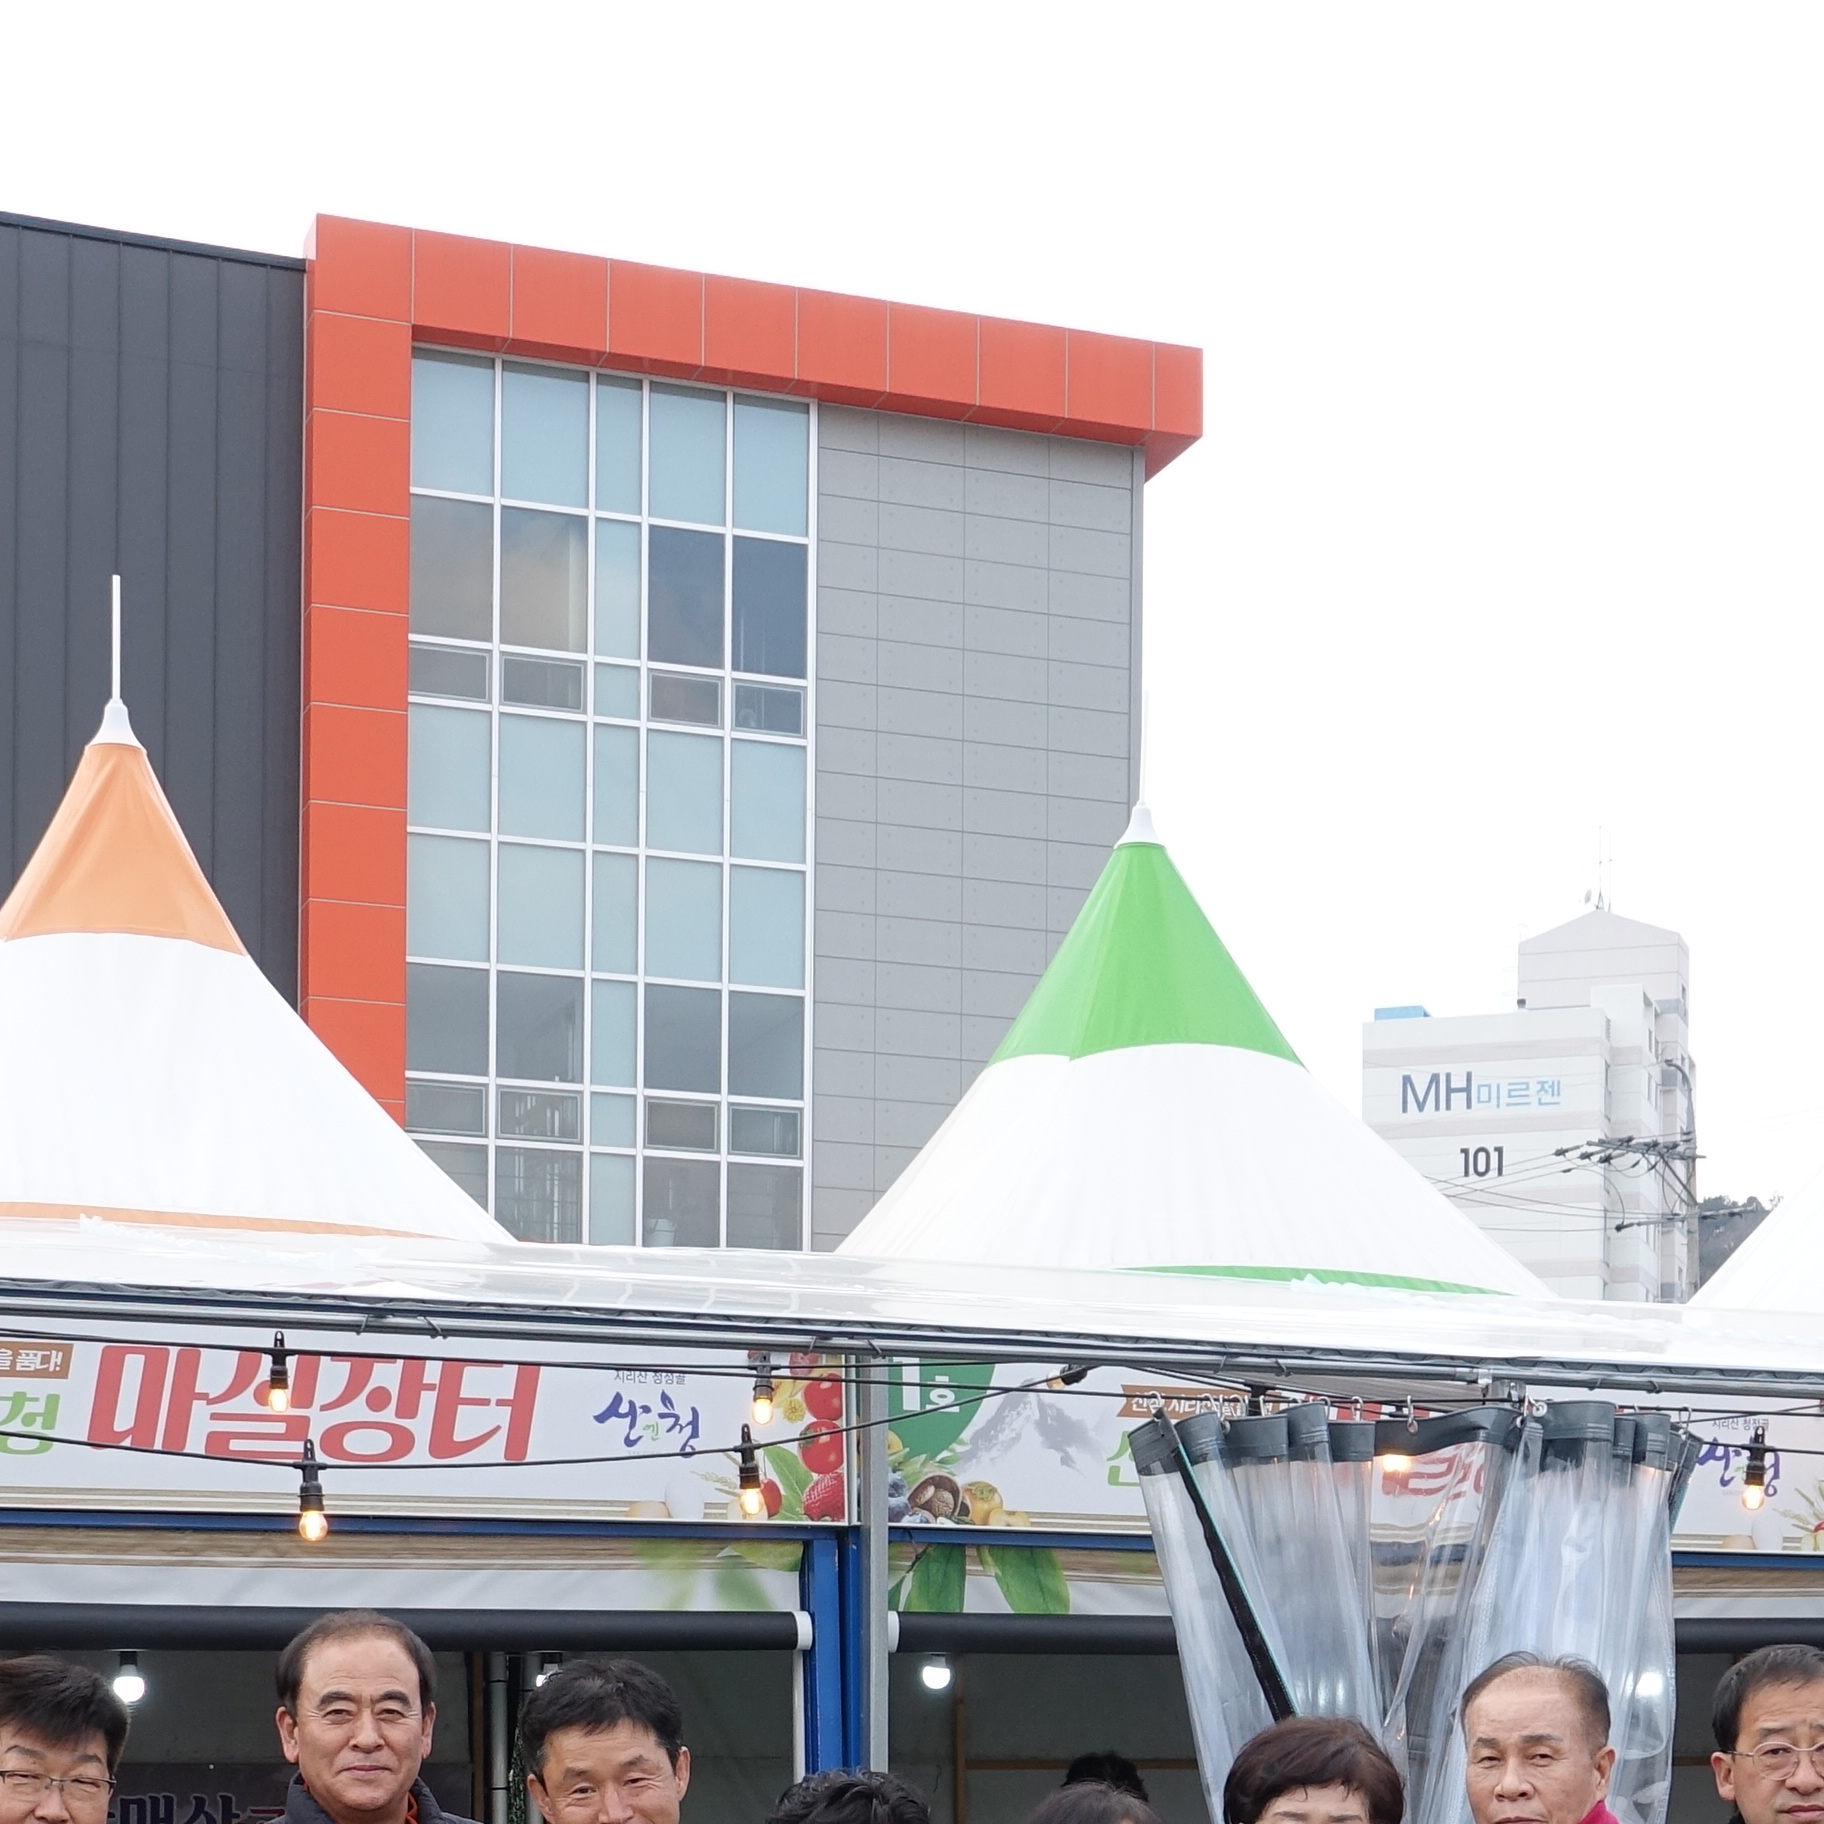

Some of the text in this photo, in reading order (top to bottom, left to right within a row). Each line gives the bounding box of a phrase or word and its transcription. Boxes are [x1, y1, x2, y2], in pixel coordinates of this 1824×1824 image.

[1460, 1146, 1504, 1178] 101
[16, 1349, 63, 1372] 품다!
[87, 1345, 542, 1463] 마실장터
